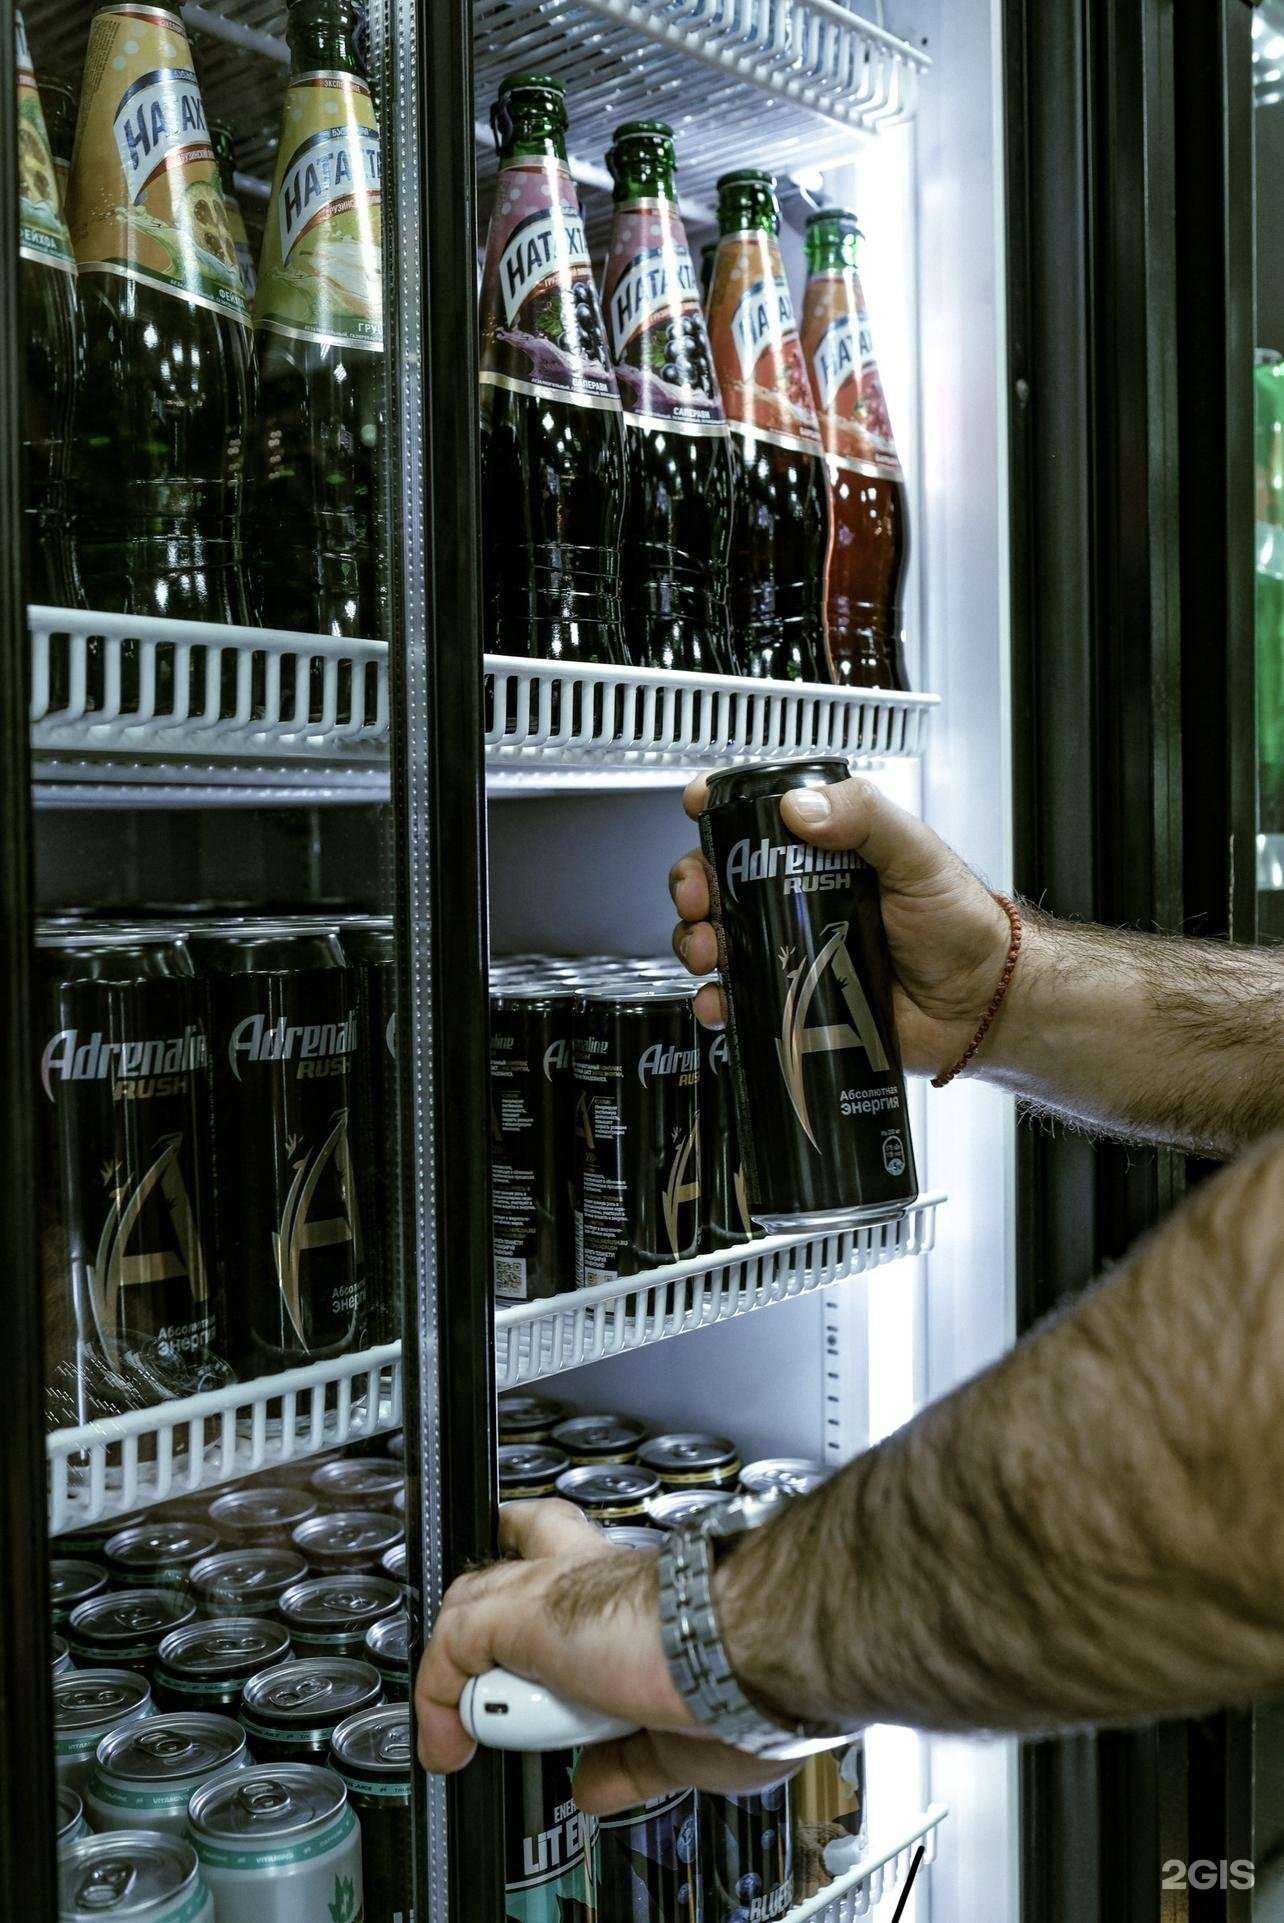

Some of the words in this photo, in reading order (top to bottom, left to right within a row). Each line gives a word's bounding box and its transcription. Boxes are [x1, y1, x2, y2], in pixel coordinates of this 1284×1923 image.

[783, 873, 851, 896] RUSH
[114, 1075, 188, 1100] RUSH
[840, 1086, 898, 1102] Абсолютная
